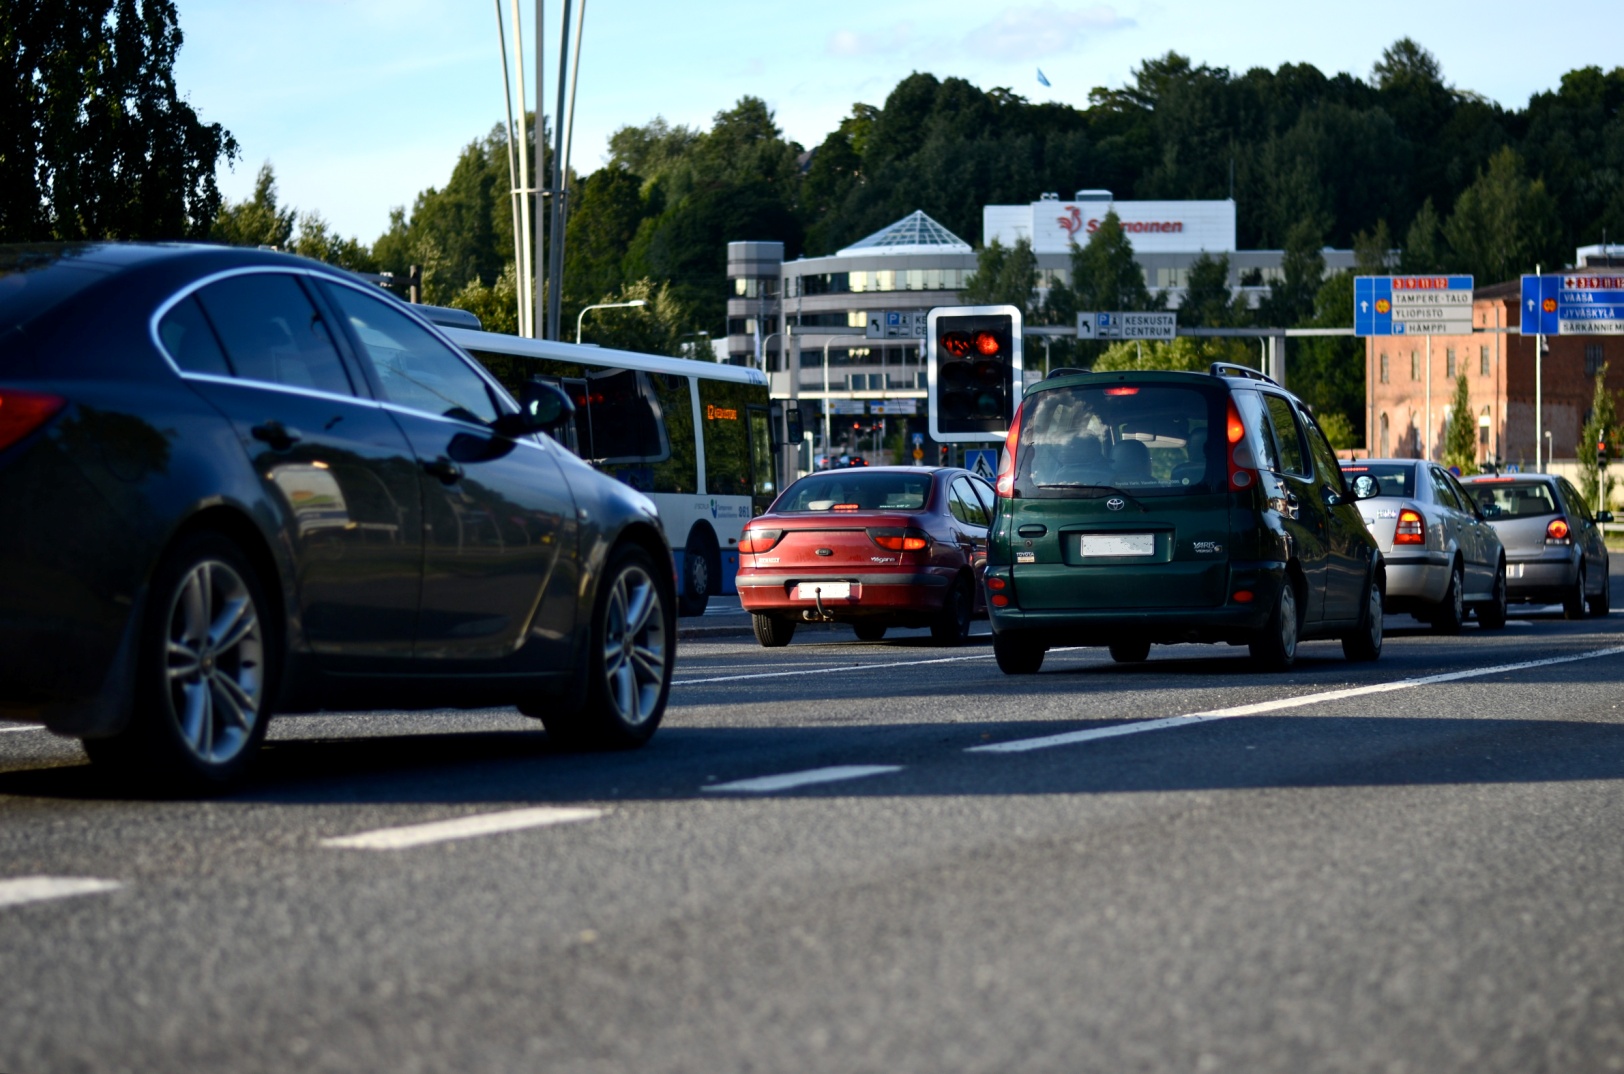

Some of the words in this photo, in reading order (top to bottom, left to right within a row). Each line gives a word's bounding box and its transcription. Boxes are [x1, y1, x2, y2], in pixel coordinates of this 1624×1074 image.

[1087, 219, 1183, 233] Srioinen
[1396, 278, 1402, 288] 3
[1408, 278, 1415, 288] 9
[1421, 278, 1430, 288] 11
[1436, 278, 1447, 288] 12
[1604, 278, 1611, 288] 11
[1564, 292, 1594, 302] VAASA
[1396, 309, 1443, 318] YLIOPISTO
[1564, 308, 1615, 318] JYVÄSKYLÄ
[1125, 316, 1174, 325] KESKUSTA
[1125, 327, 1171, 336] CENTRUM
[1409, 323, 1447, 332] HÄMPPI
[1193, 541, 1215, 549] YARIS
